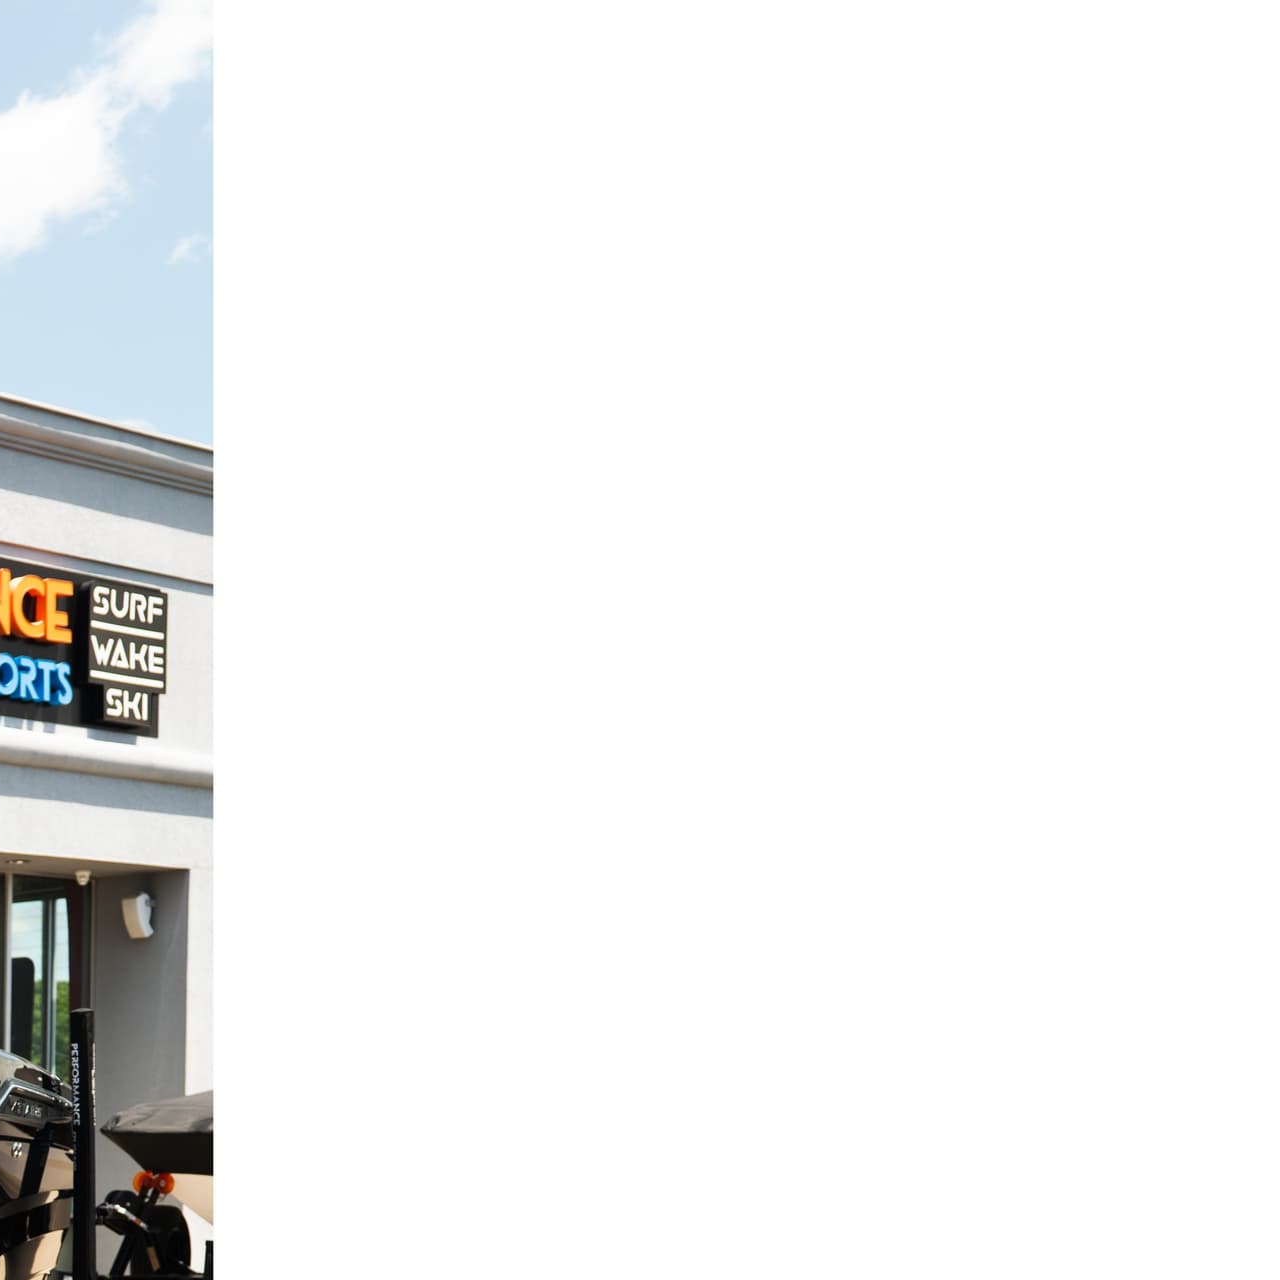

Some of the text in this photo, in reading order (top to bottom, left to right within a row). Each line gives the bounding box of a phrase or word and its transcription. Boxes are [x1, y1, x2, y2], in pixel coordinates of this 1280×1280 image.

[93, 586, 163, 624] SURF
[91, 635, 164, 674] WAKE
[106, 688, 149, 721] SKI
